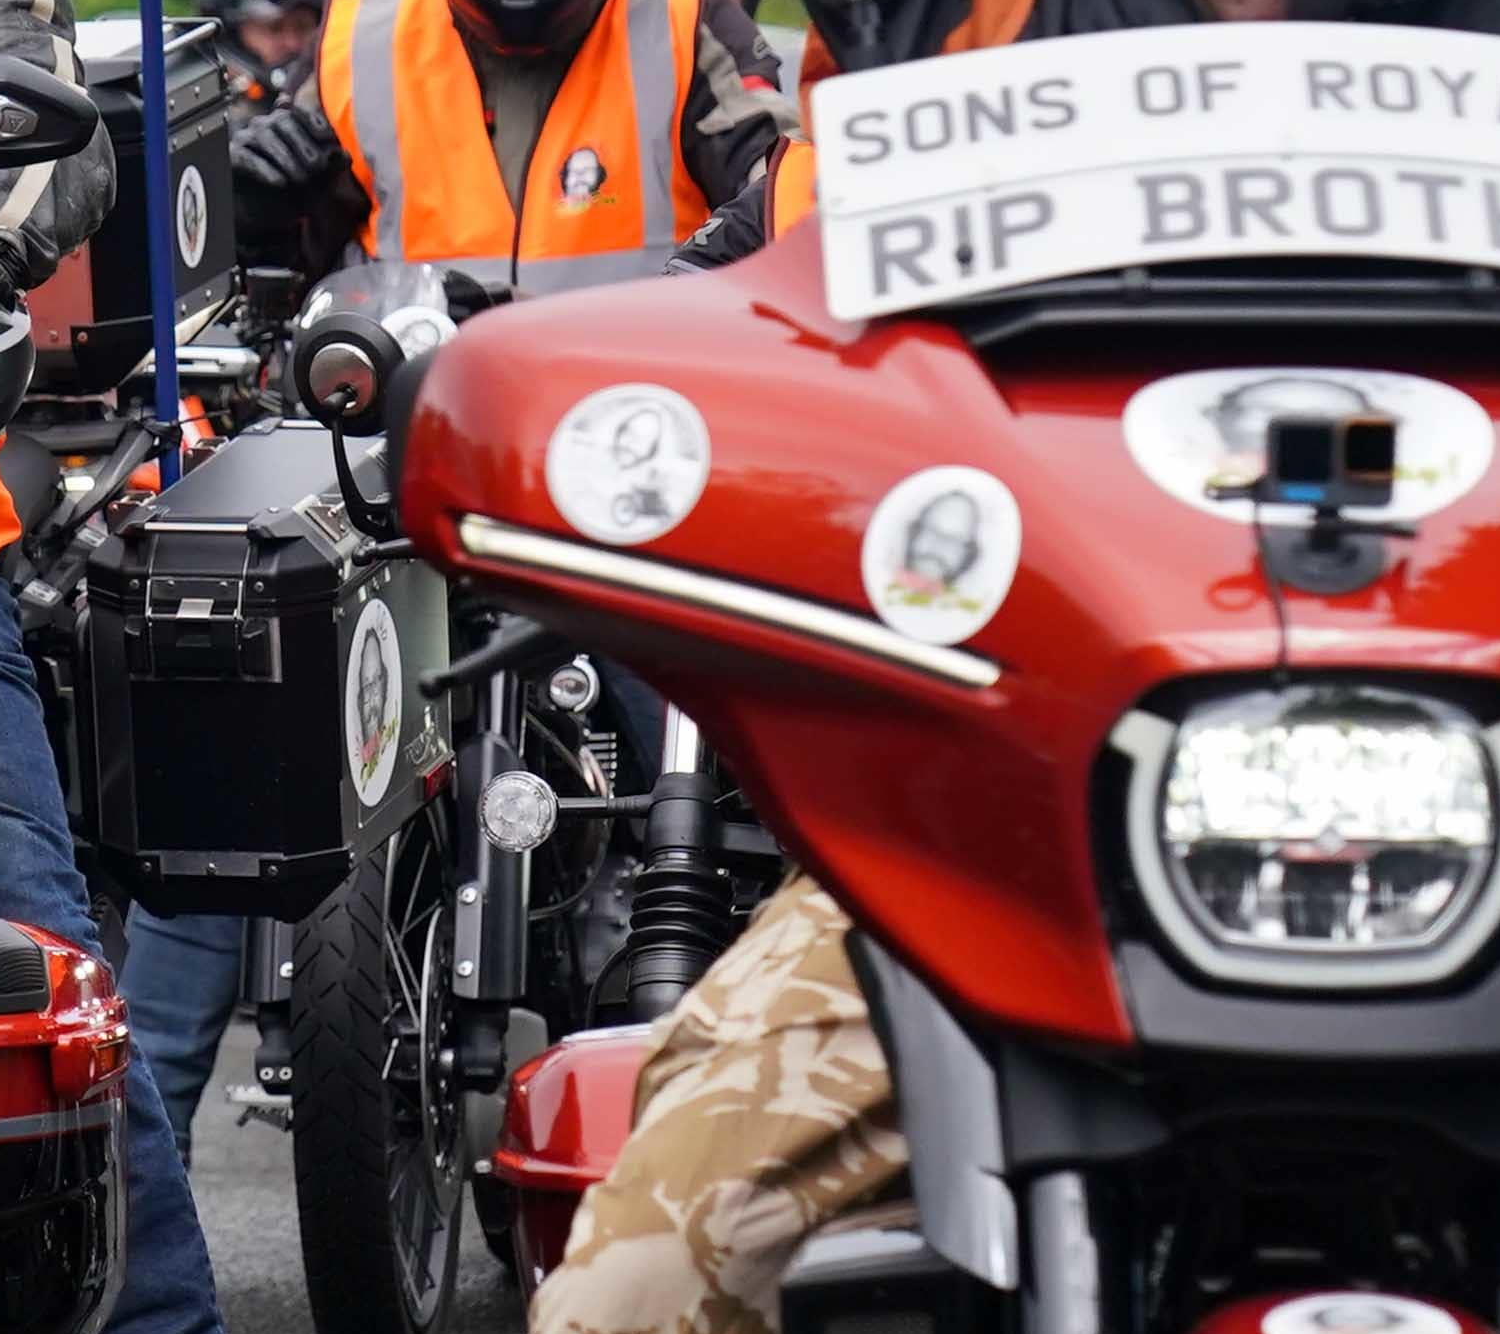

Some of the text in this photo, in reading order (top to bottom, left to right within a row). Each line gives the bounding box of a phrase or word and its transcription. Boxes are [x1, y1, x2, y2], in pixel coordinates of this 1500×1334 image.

[843, 77, 1078, 165] SONS
[1135, 61, 1246, 117] OF
[867, 191, 1054, 297] RIP
